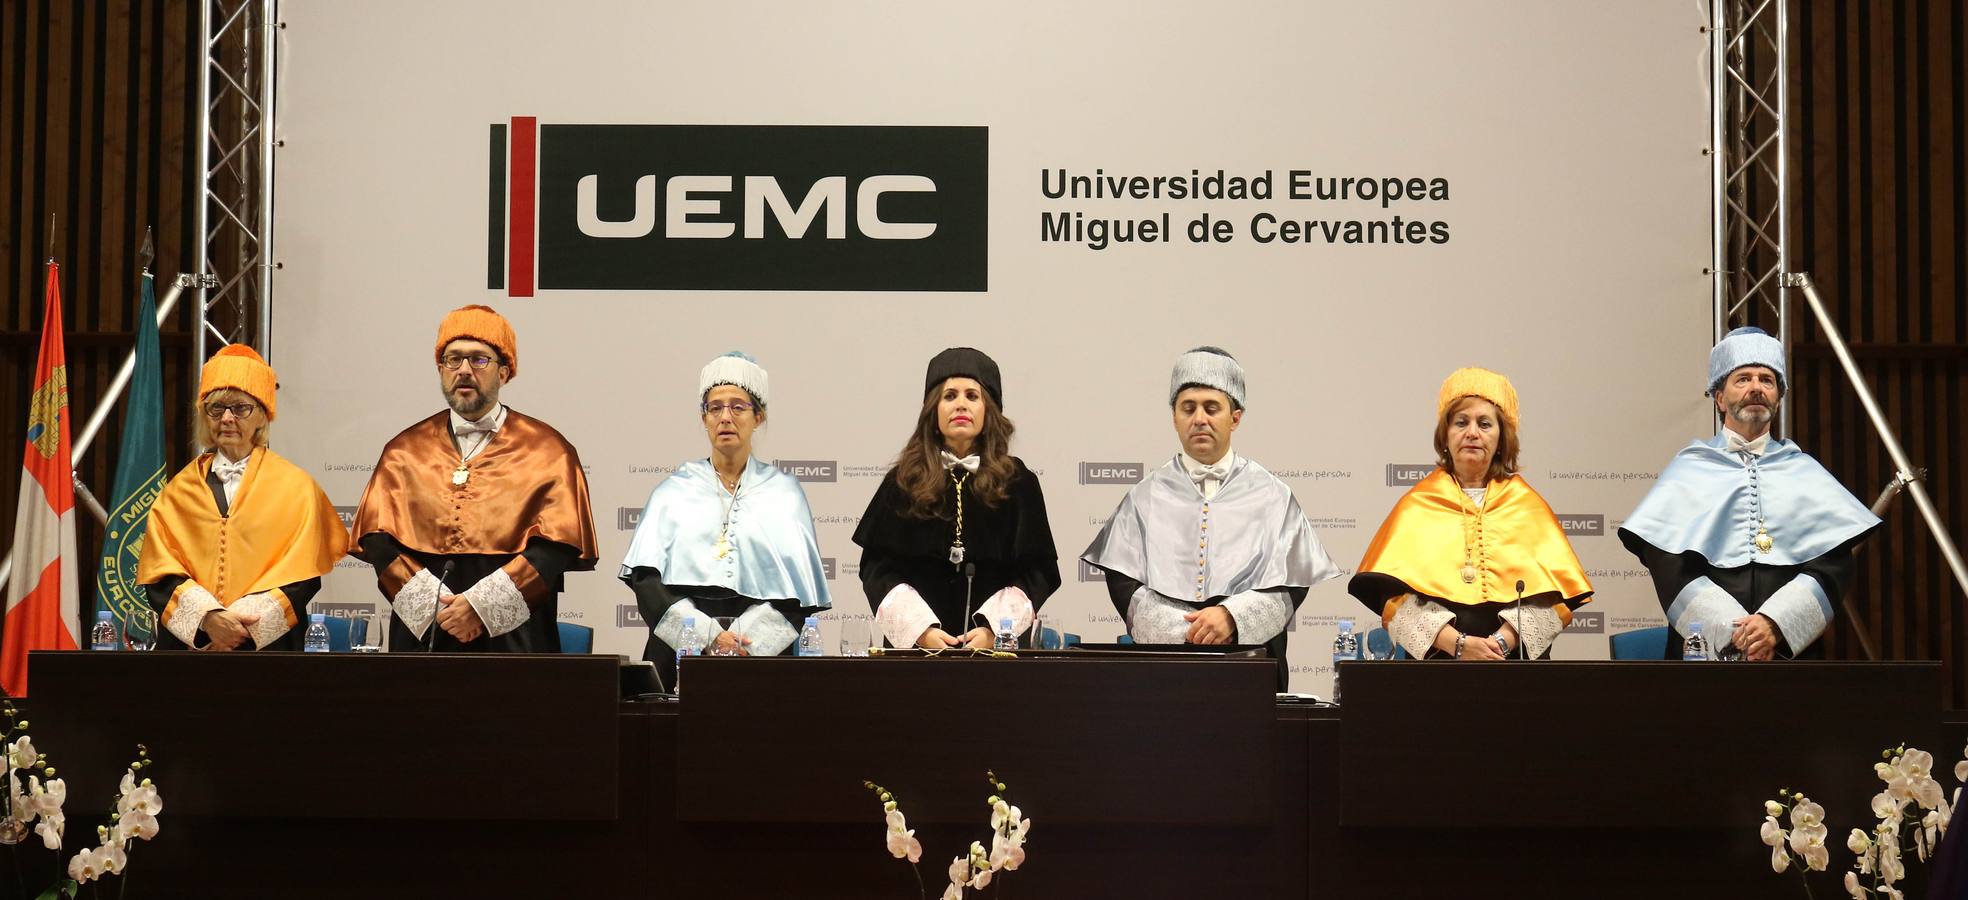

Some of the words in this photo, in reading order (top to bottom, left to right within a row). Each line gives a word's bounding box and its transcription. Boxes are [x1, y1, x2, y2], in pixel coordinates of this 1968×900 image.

[1041, 168, 1273, 200] Universidad
[1289, 170, 1450, 208] Europea
[576, 174, 938, 240] UEMC
[1041, 212, 1169, 250] Miguel
[1187, 213, 1234, 243] de
[1250, 212, 1450, 244] Cervantes
[629, 464, 637, 473] la
[1089, 468, 1138, 478] UEMC
[1302, 470, 1313, 478] en
[1315, 470, 1352, 481] persona
[1549, 471, 1557, 480] la
[1559, 471, 1608, 480] universidad
[1610, 472, 1621, 480] en
[1623, 472, 1659, 482] persona
[843, 516, 853, 524] en
[1560, 520, 1598, 530] EMC
[1611, 570, 1621, 578] en
[1088, 613, 1096, 623] la
[1567, 618, 1598, 628] MC
[1302, 665, 1313, 673] en
